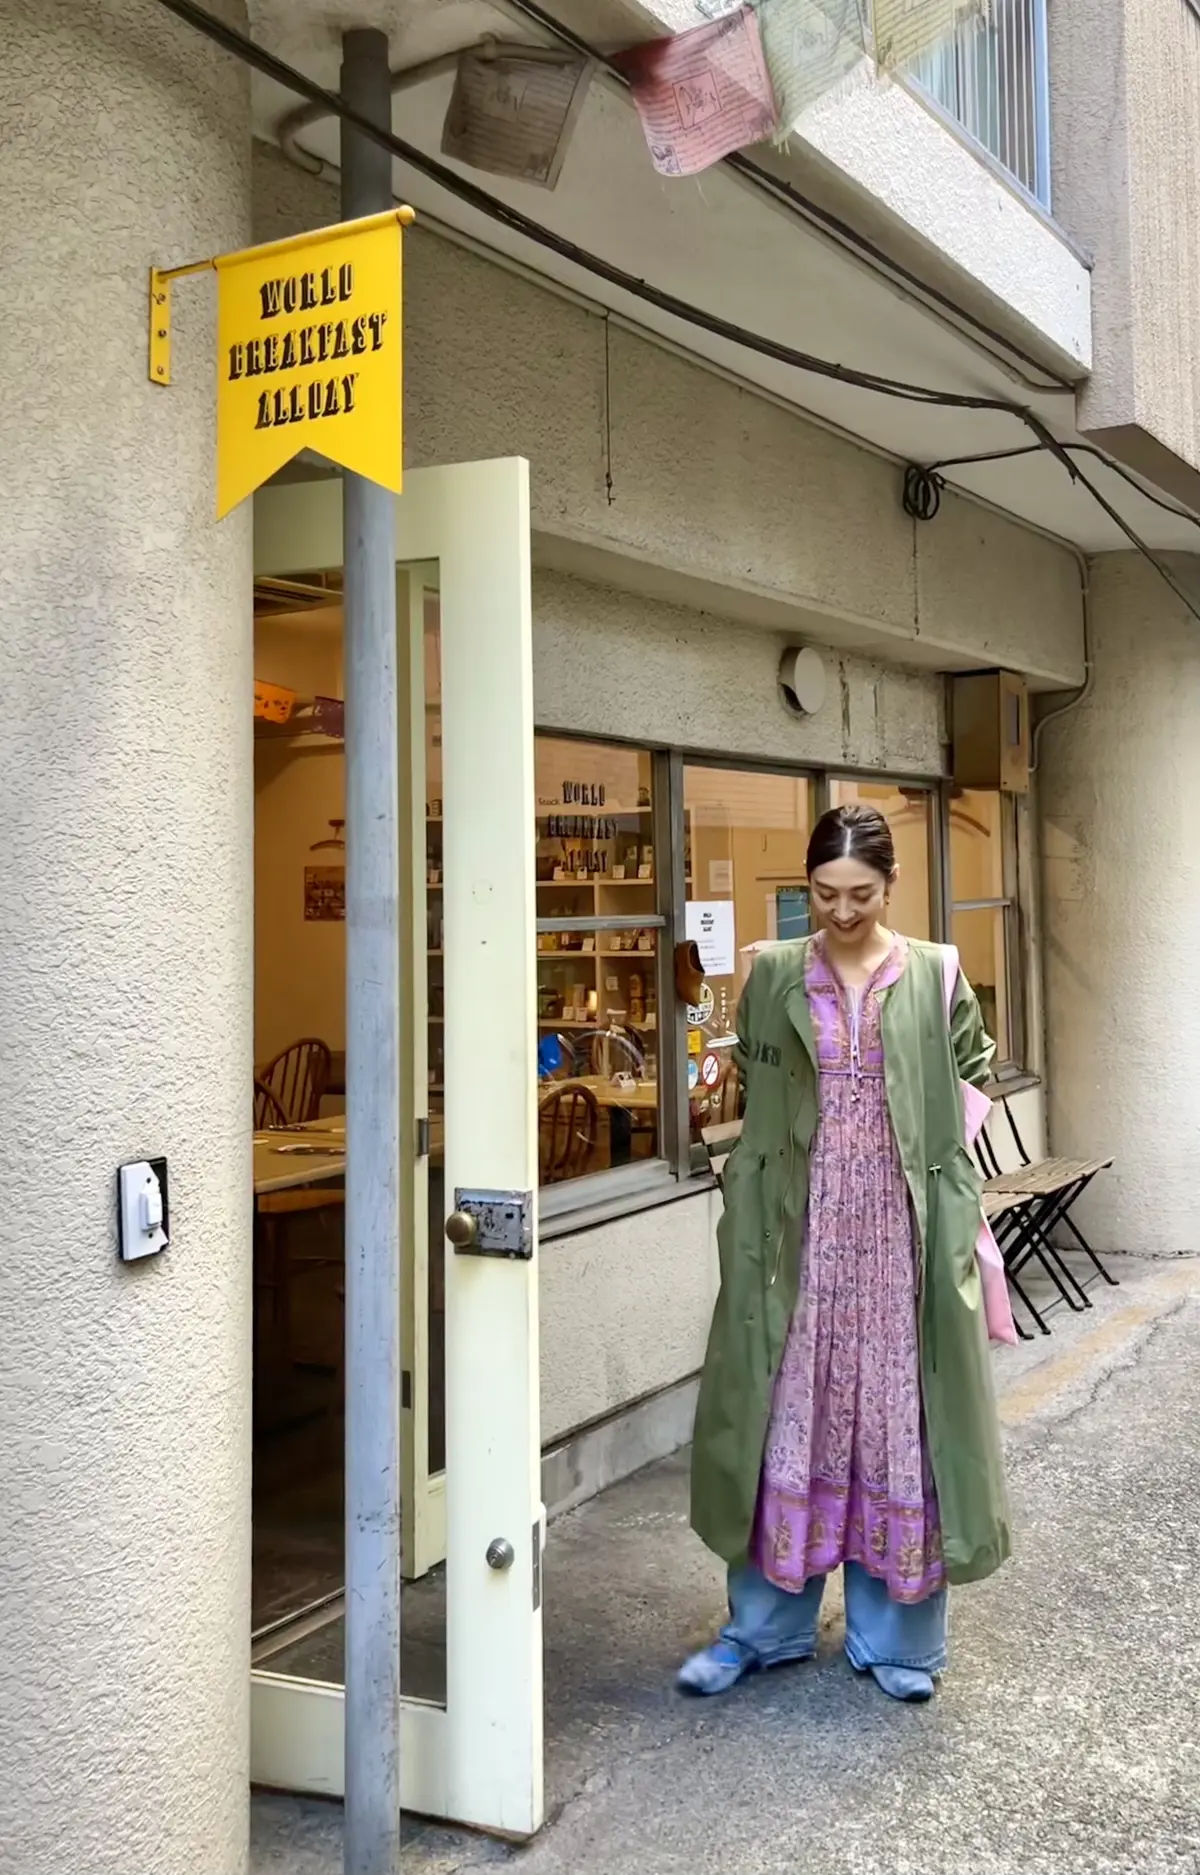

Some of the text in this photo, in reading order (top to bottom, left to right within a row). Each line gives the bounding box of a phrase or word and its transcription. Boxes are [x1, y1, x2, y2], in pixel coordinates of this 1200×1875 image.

[260, 261, 354, 320] WORLD
[229, 312, 388, 381] BREAKFAST
[562, 781, 606, 807] WORLD
